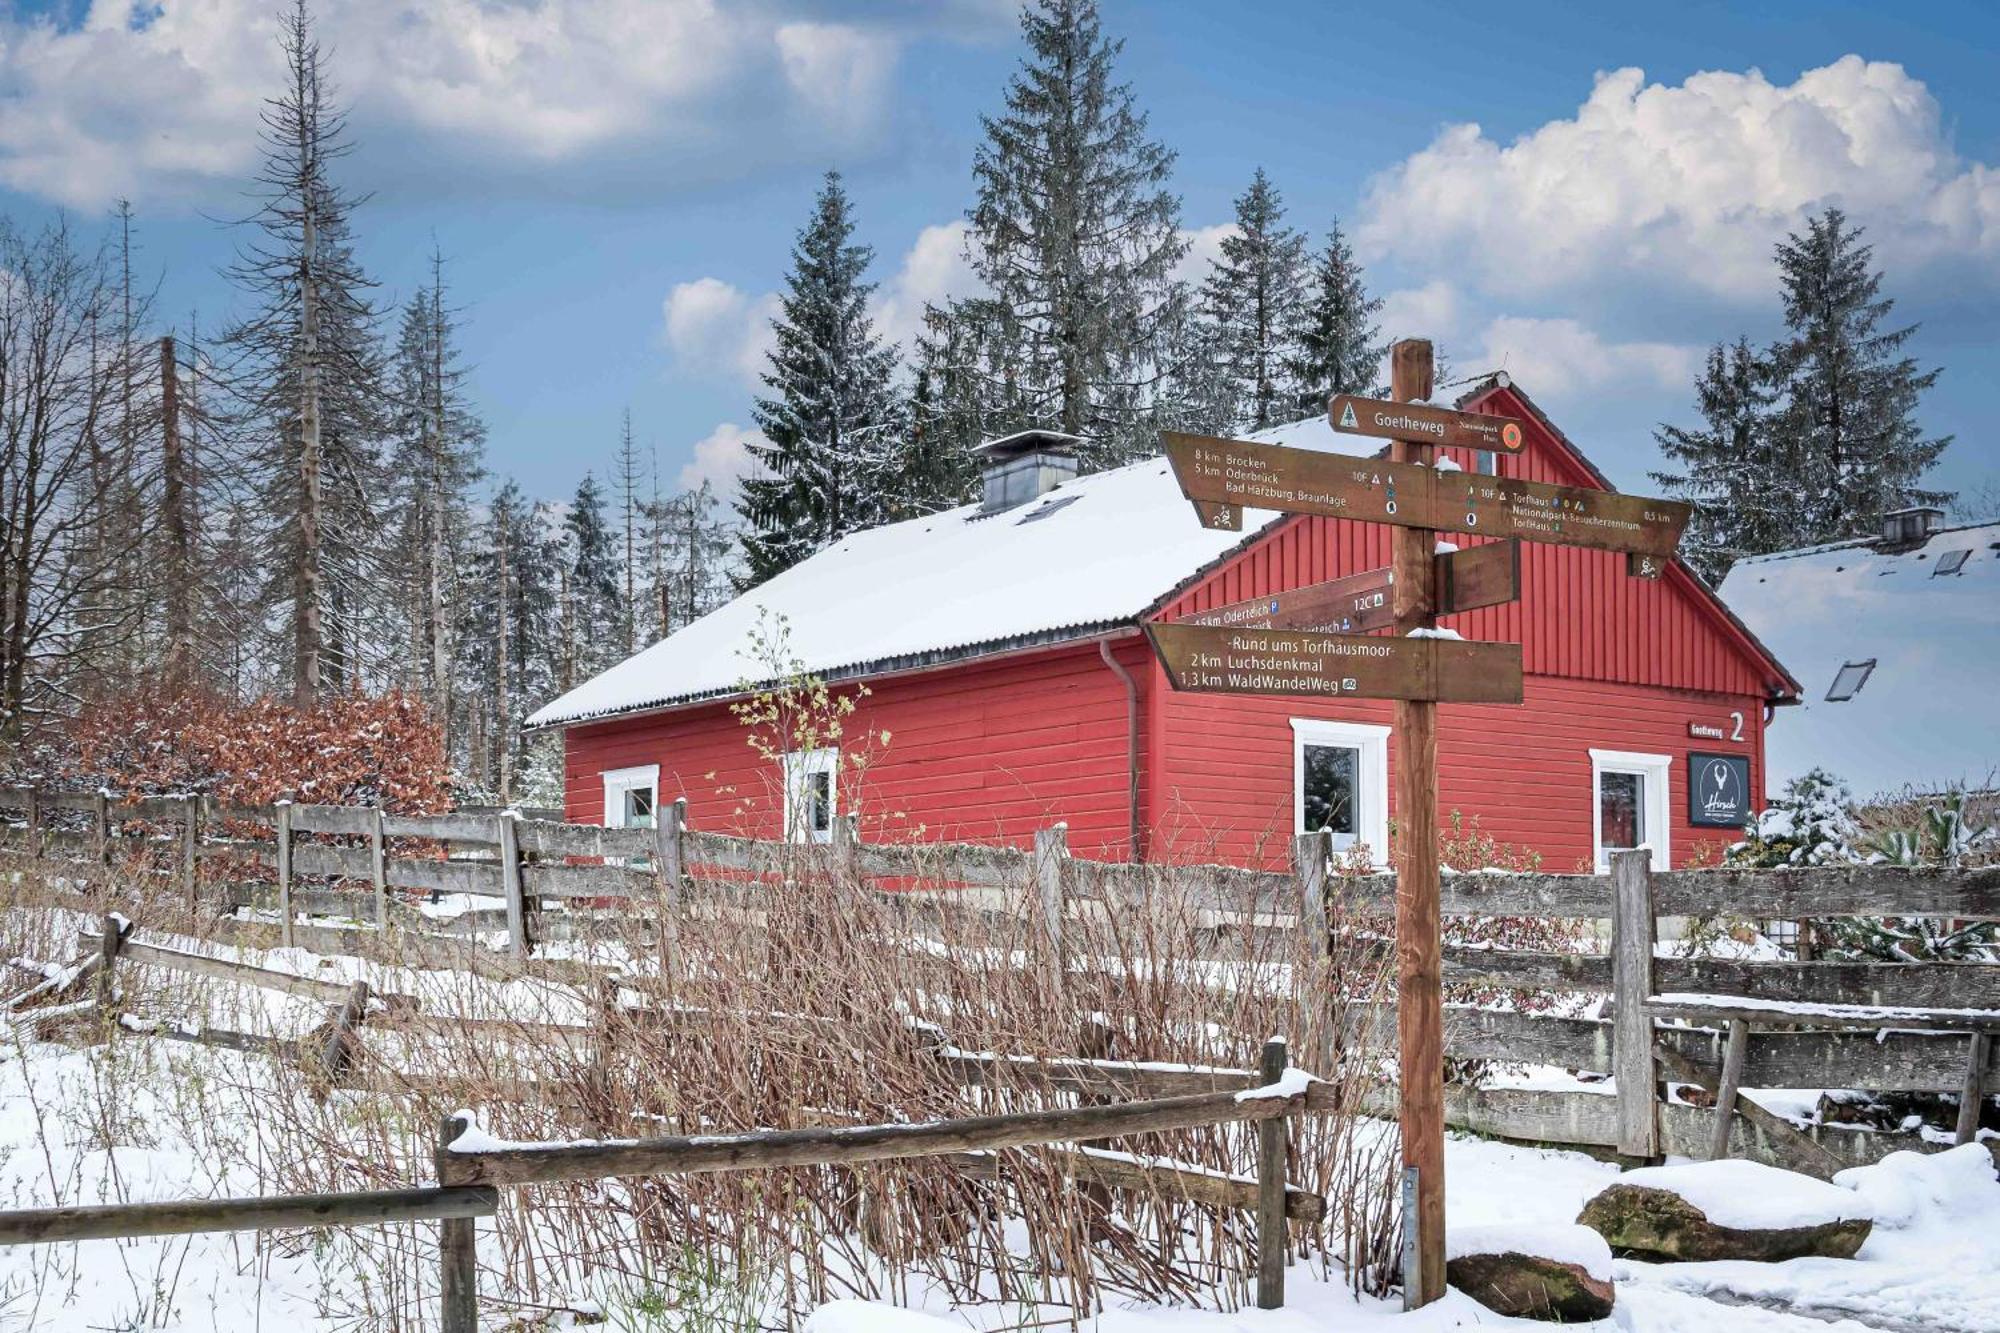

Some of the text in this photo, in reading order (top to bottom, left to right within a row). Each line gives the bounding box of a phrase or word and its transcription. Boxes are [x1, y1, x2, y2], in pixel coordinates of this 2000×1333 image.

[1375, 412, 1444, 437] Goetheweg
[1195, 450, 1266, 468] 8 km Brocken
[1195, 464, 1278, 484] 5 km Oderbrück
[1226, 482, 1244, 494] Bad
[1298, 491, 1347, 507] Braunlage
[1513, 492, 1549, 506] Torfhaus
[1354, 595, 1372, 611] 12C
[1224, 603, 1269, 624] Oderteich
[1272, 641, 1298, 653] ums
[1191, 653, 1323, 672] 2 km Luchsdenkmal
[1181, 671, 1339, 694] 1,3 km WaldWandelWeg
[1730, 711, 1745, 742] 2
